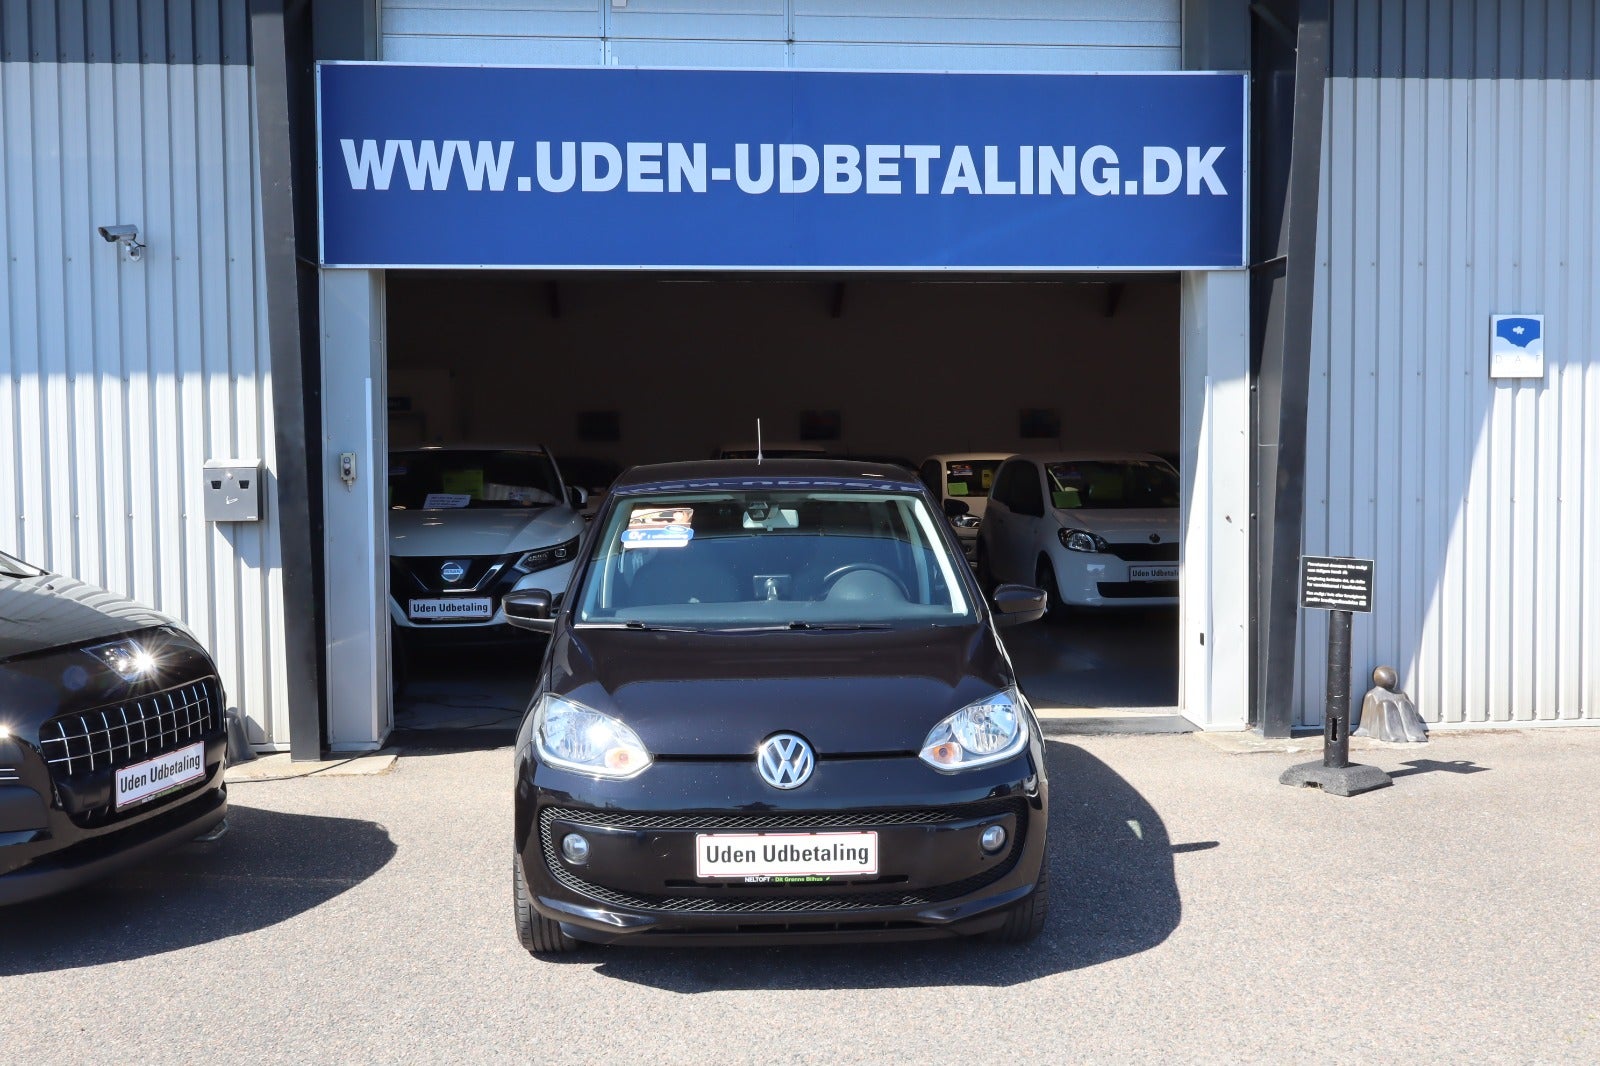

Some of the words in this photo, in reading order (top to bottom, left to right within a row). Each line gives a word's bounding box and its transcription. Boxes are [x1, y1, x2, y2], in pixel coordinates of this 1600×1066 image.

[339, 138, 1228, 197] WWW.UDEN-UDBETALING.DK
[413, 603, 436, 613] Uden
[439, 602, 488, 613] Udbetaling
[120, 774, 146, 793] Uden
[150, 754, 200, 782] Udbetaling
[706, 845, 756, 863] Uden
[763, 843, 869, 865] Udbetaling
